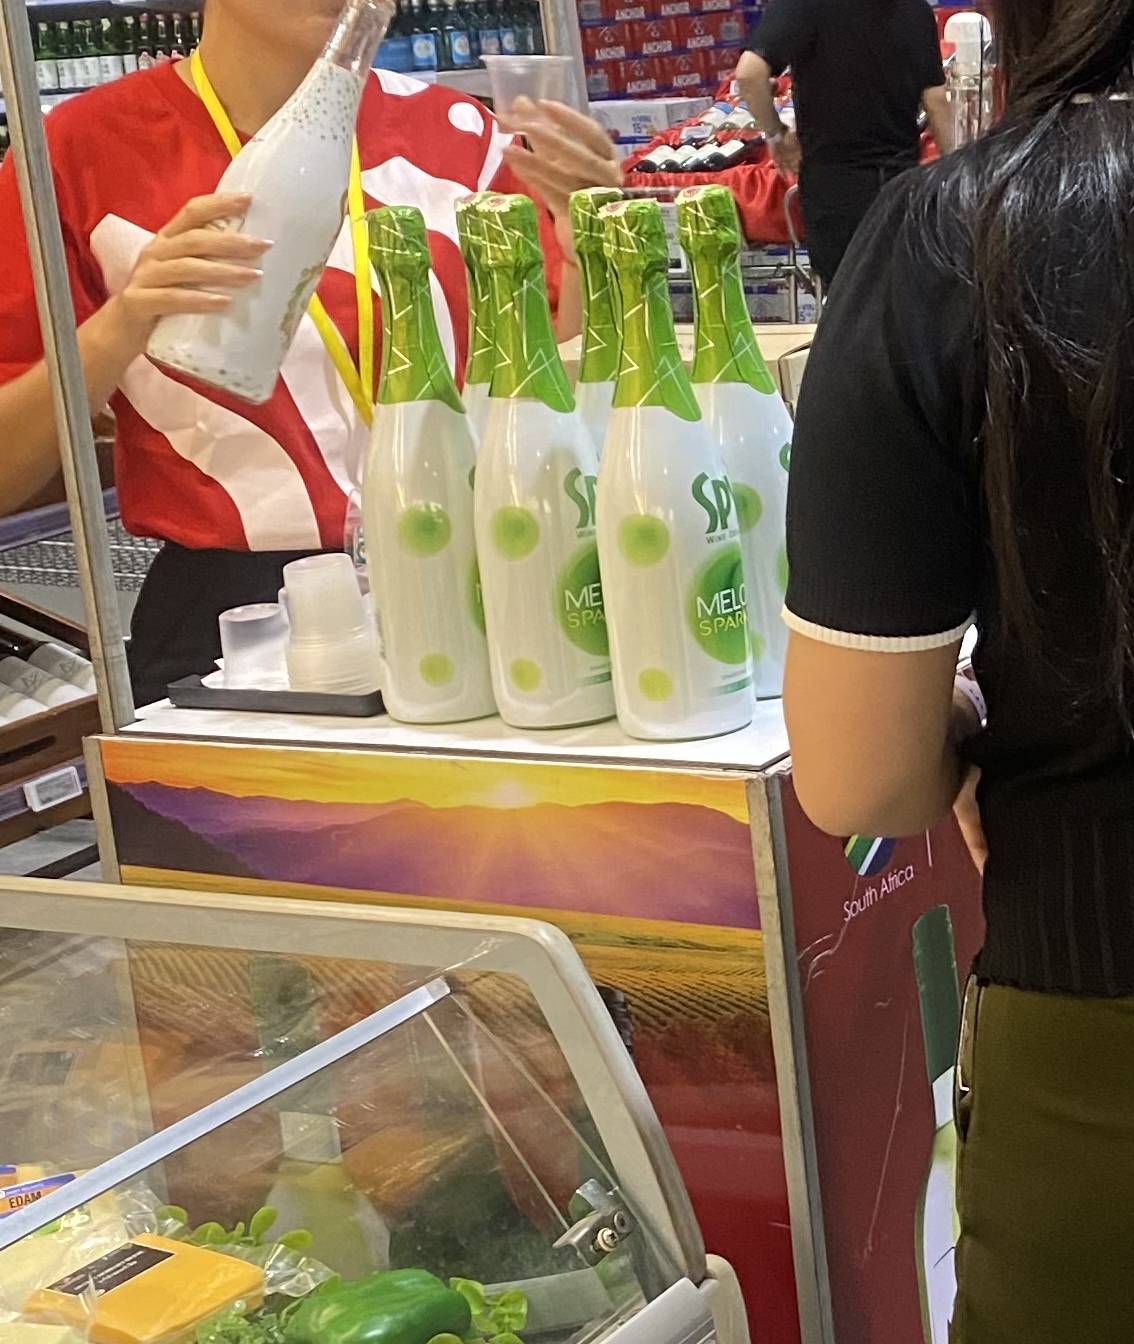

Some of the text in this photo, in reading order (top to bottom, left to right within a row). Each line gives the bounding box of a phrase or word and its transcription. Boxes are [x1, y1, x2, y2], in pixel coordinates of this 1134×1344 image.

[564, 583, 602, 611] ME
[843, 865, 914, 922] South Africa
[8, 1191, 42, 1209] EDAM
